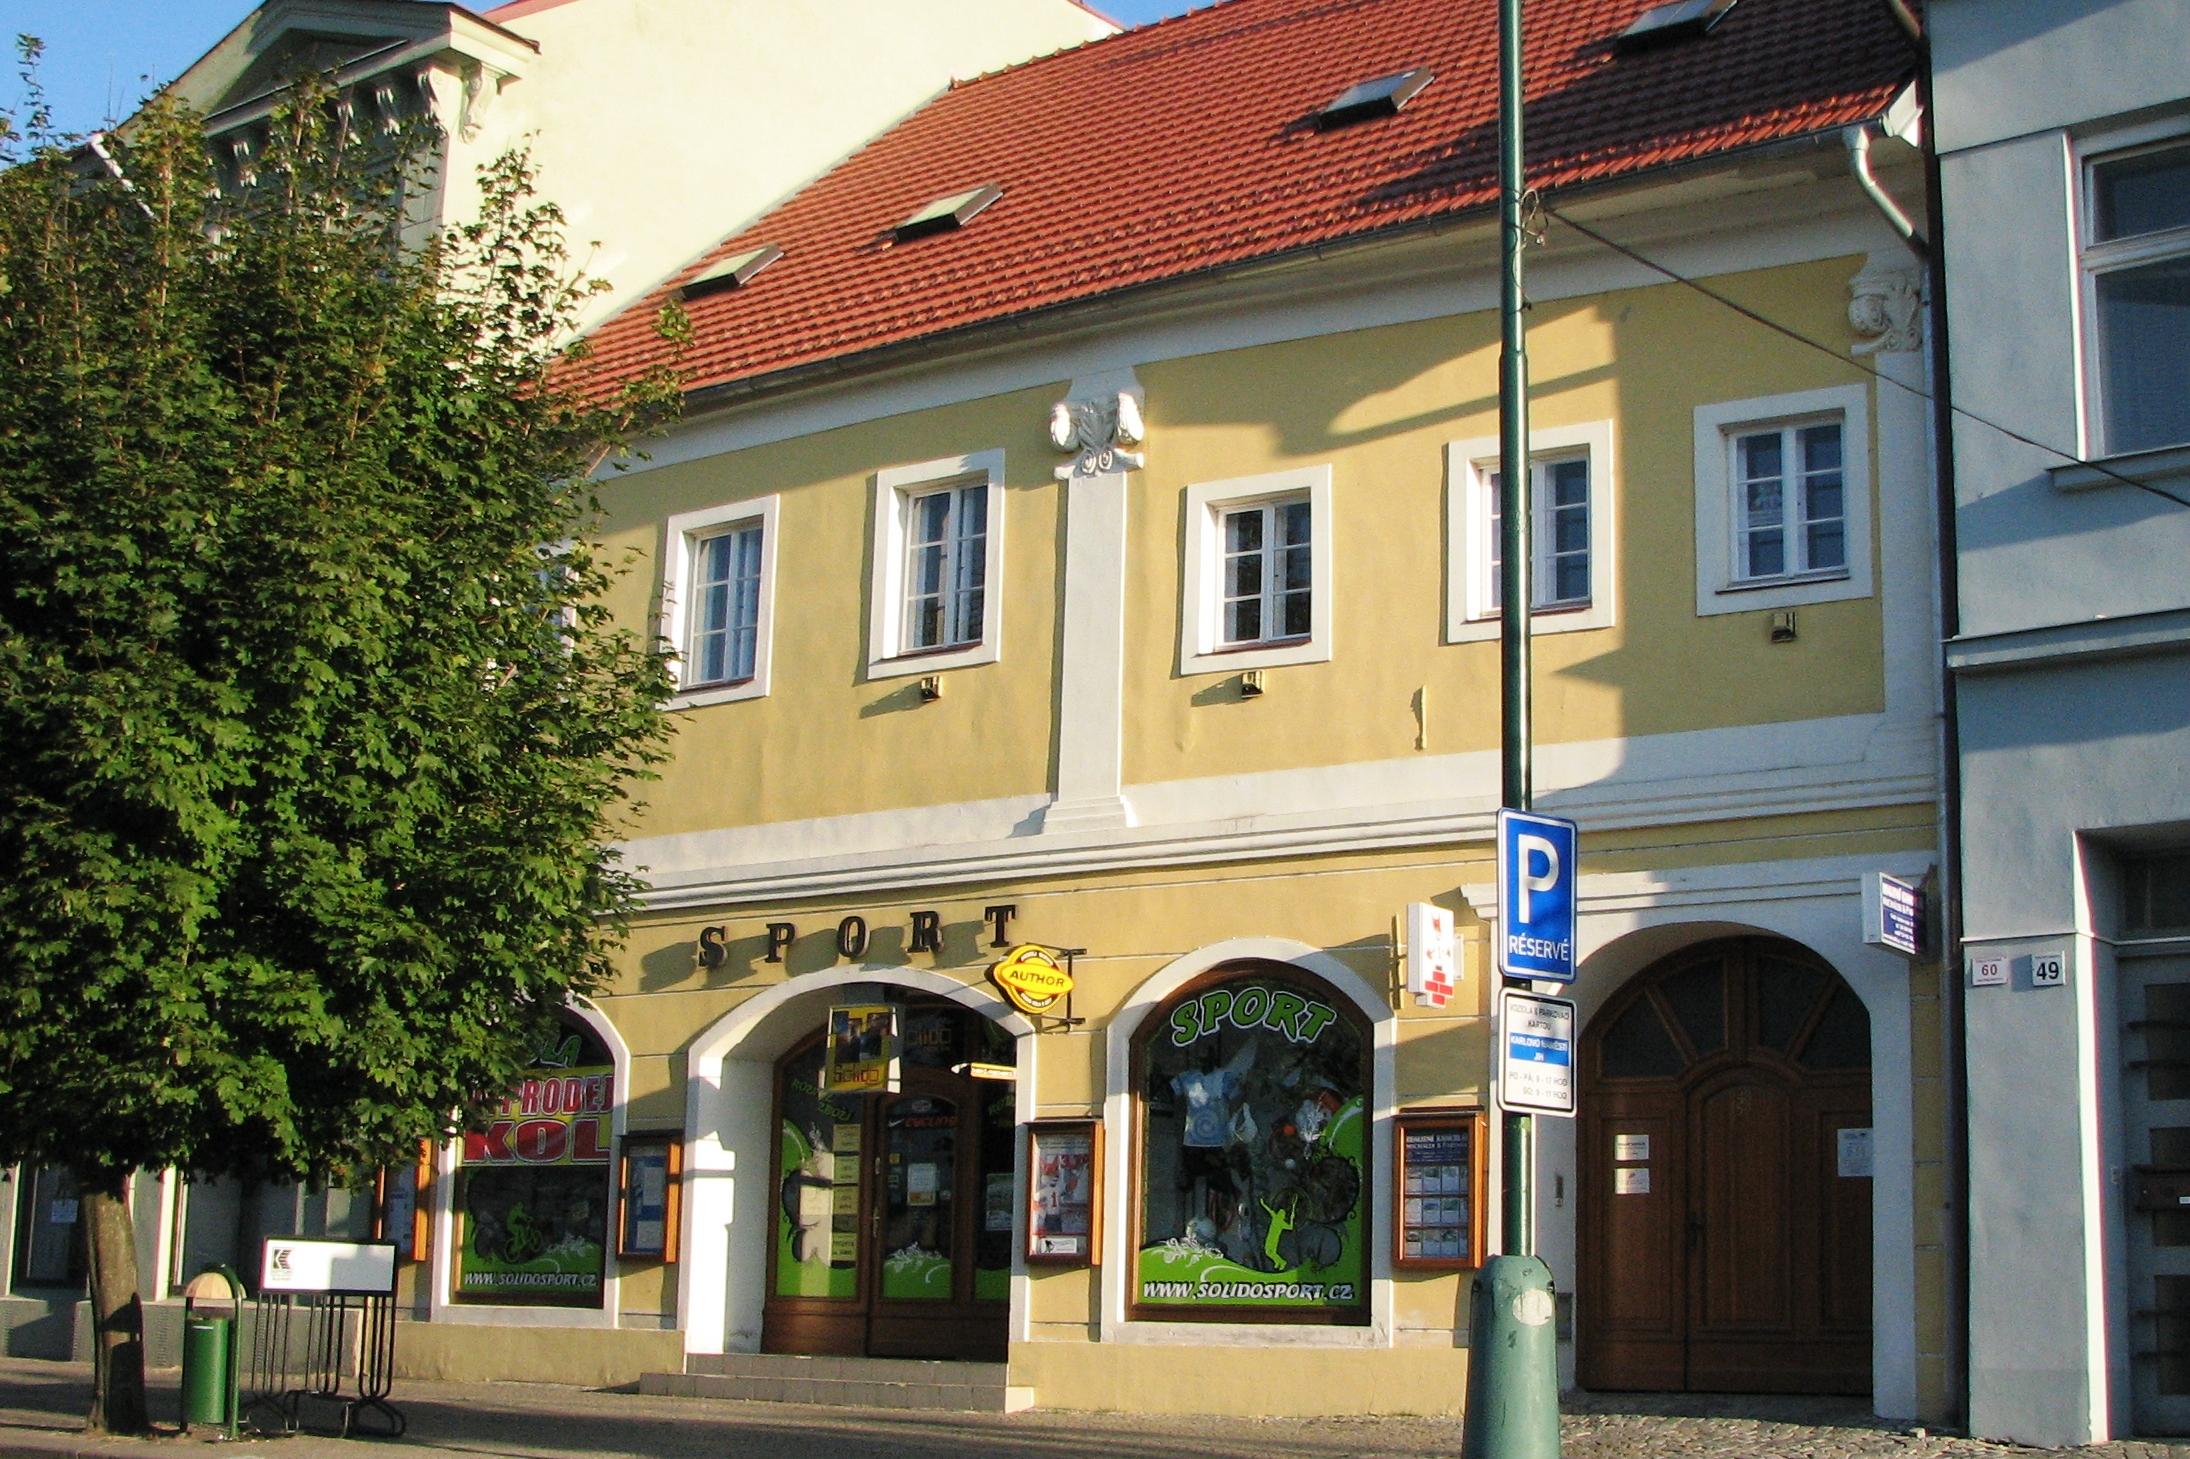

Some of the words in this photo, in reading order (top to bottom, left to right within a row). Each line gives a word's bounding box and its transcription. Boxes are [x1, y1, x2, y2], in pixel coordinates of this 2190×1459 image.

[1517, 833, 1560, 924] P
[698, 904, 1017, 967] SPORT
[1508, 932, 1570, 961] RÉSERVÉ
[1009, 970, 1065, 988] AUTHOR
[1981, 963, 1998, 976] 60
[2036, 961, 2060, 980] 49
[1170, 986, 1338, 1047] SPORT
[463, 1119, 612, 1163] KOL
[464, 1271, 597, 1286] WWW.SOLIDOSPORT.CZ
[1143, 1280, 1354, 1301] WWW.SOLIDOSPORT.CZ
